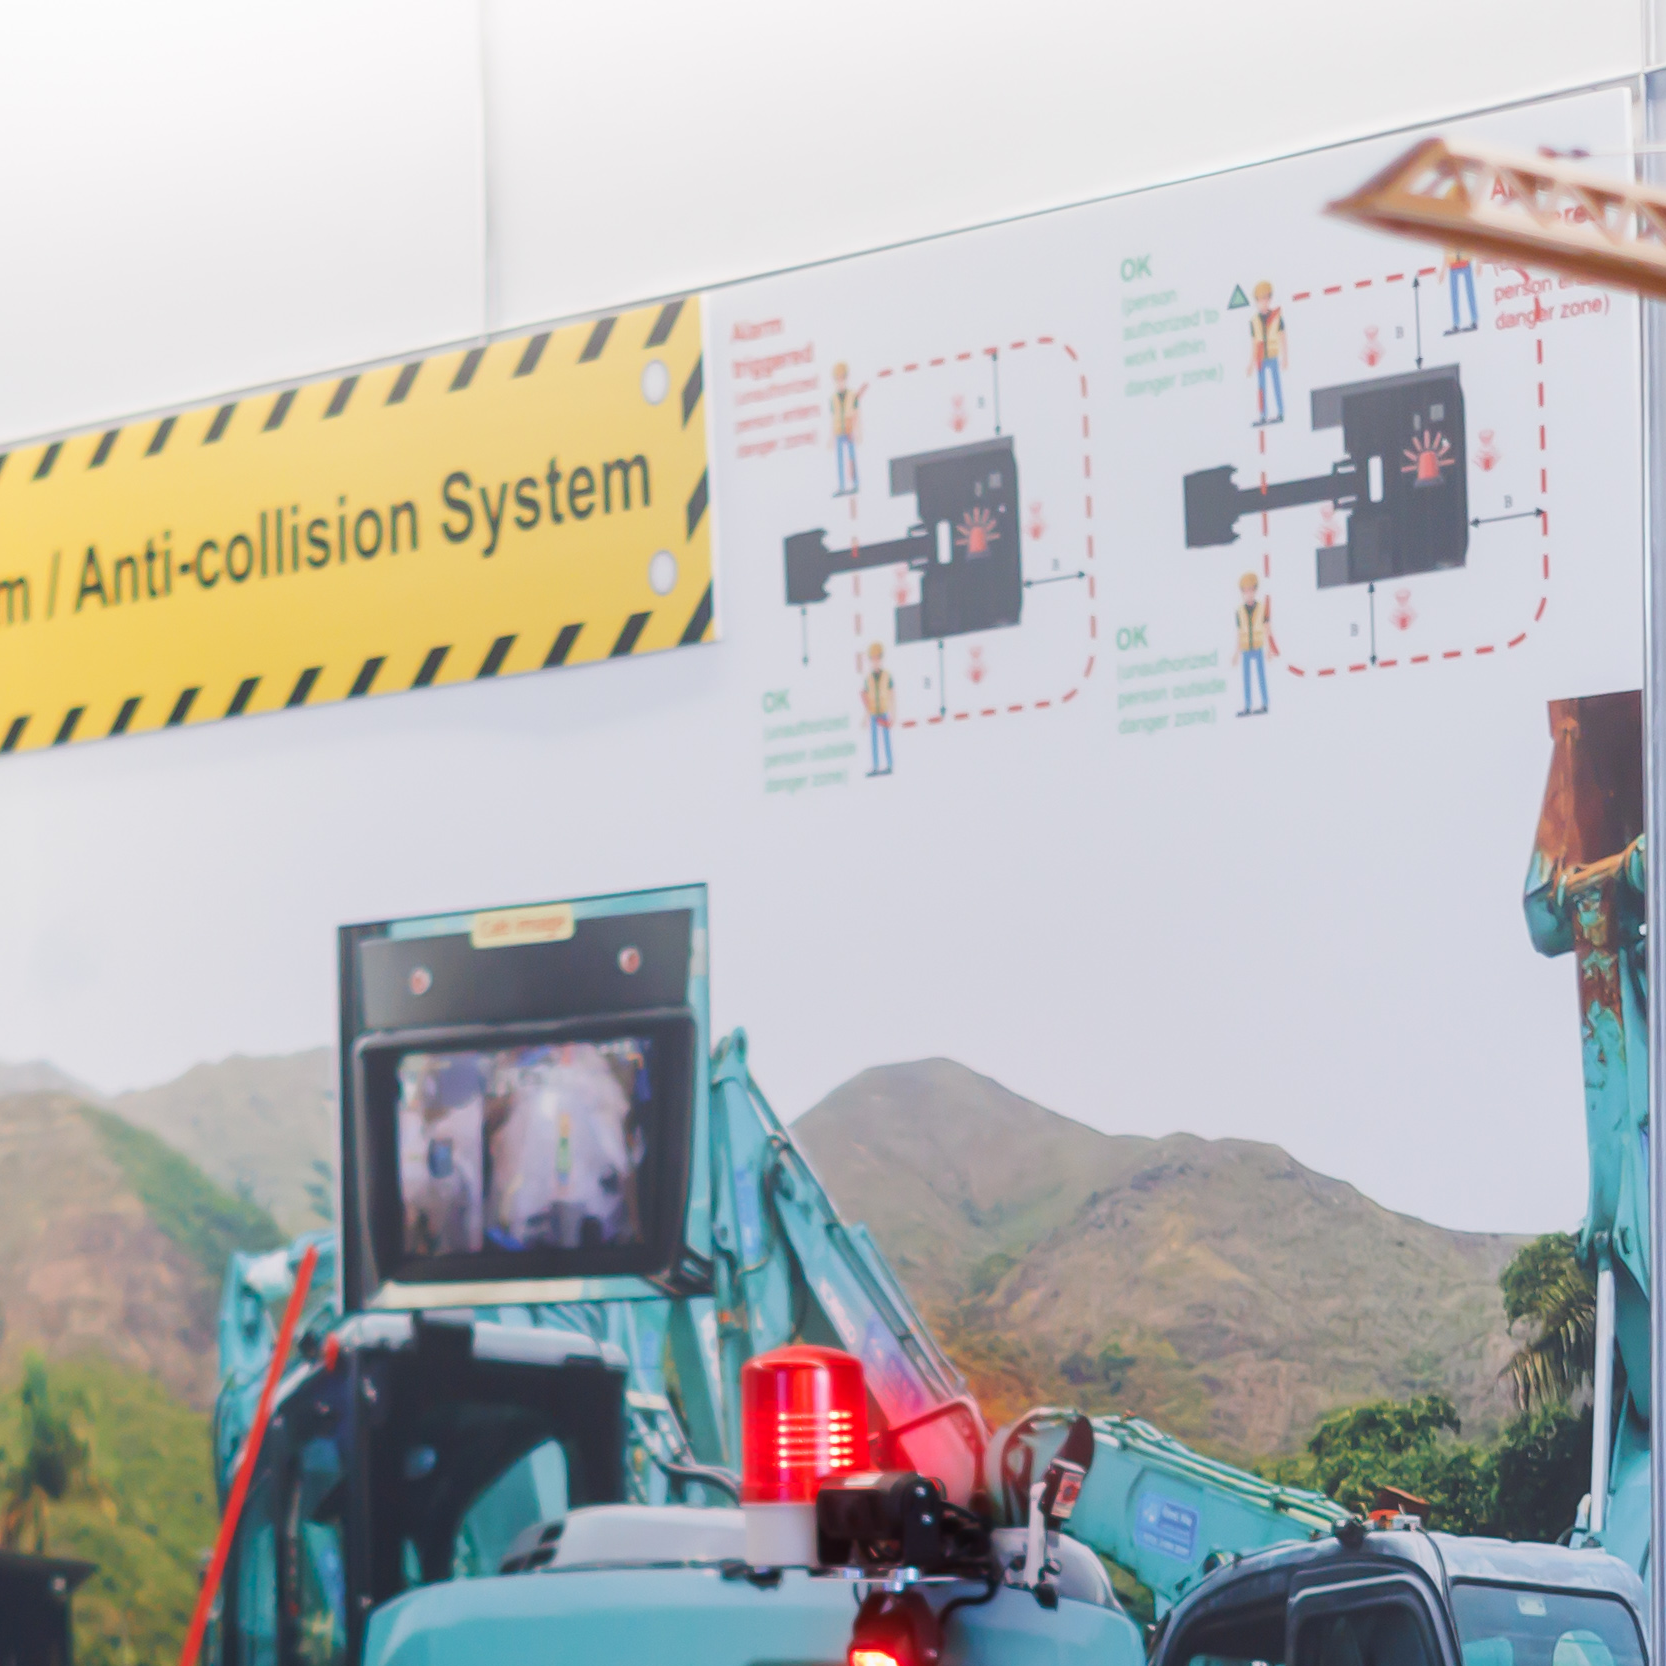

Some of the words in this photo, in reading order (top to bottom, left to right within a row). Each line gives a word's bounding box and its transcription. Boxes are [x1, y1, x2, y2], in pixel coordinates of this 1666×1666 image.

[1119, 253, 1152, 282] OK
[1495, 277, 1552, 305] person
[1495, 304, 1554, 330] danger
[1560, 292, 1610, 319] zone)
[75, 495, 420, 615] Anti-collision
[441, 452, 652, 557] System
[1116, 624, 1149, 651] OK
[762, 688, 791, 714] OK
